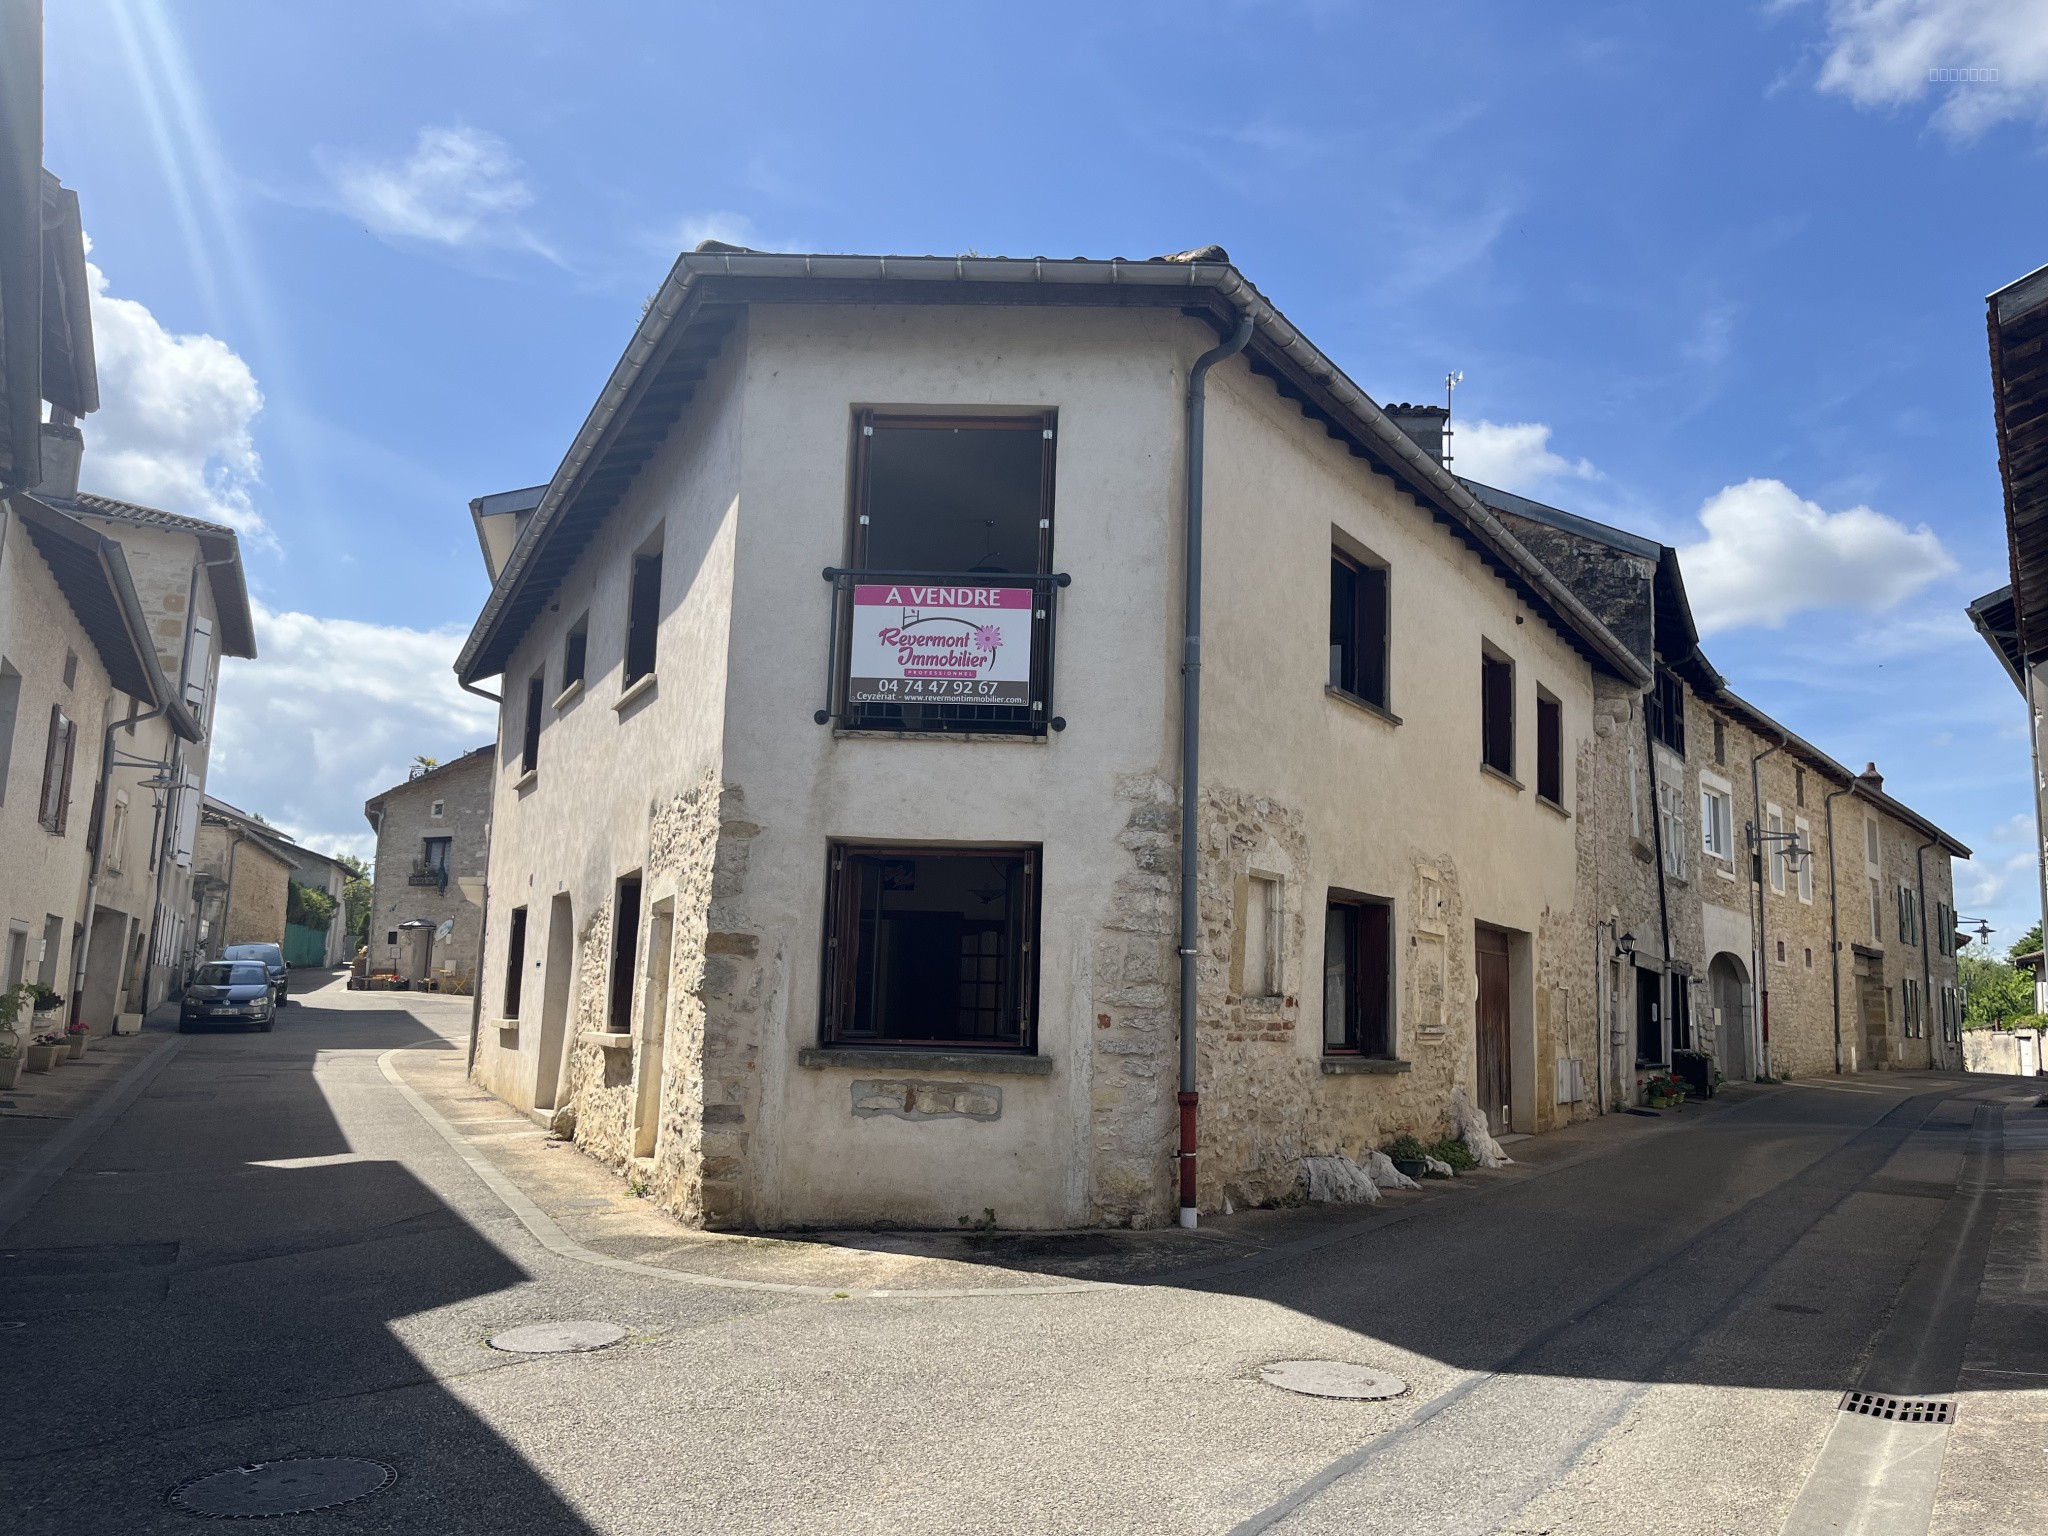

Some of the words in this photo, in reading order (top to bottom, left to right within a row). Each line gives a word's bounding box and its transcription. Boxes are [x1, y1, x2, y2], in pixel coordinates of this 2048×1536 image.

[885, 587, 903, 604] A
[910, 587, 1001, 606] VENDRE
[879, 627, 970, 648] Revermont
[897, 646, 988, 668] Immobilier
[907, 669, 973, 677] PROFESSIONNEL
[878, 679, 899, 692] 04
[904, 680, 924, 693] 74
[928, 680, 949, 694] 47
[953, 681, 973, 695] 92
[978, 681, 999, 695] 67
[856, 691, 897, 702] Ceyzériat
[904, 693, 1022, 704] www.revermontimmobilier.com
